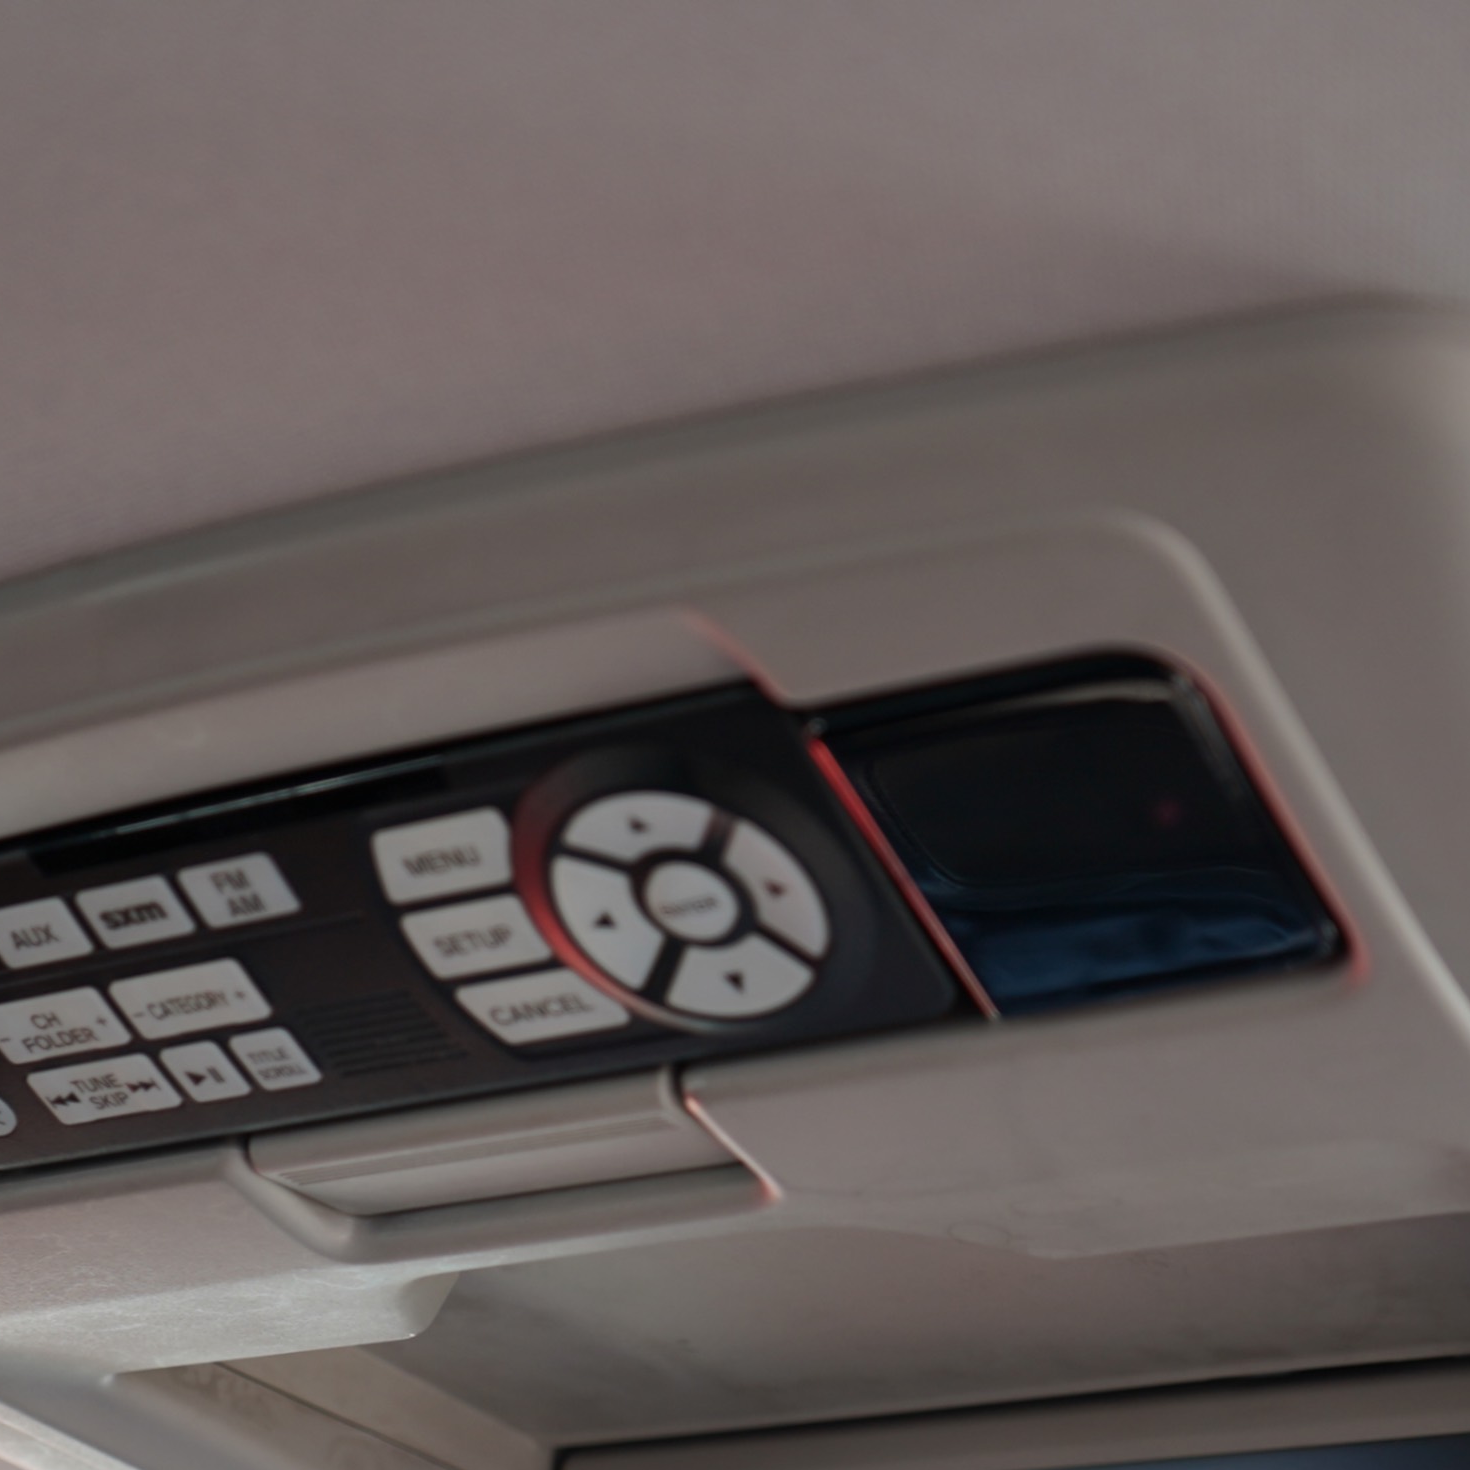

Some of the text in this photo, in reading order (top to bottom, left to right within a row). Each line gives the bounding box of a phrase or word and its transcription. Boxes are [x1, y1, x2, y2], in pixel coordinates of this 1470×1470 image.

[402, 845, 481, 876] MENU
[10, 925, 59, 950] AUX
[434, 924, 512, 956] SETUP
[146, 990, 231, 1022] CATEGORY
[489, 993, 593, 1028] CANCEL
[30, 1012, 61, 1032] CH
[21, 1026, 100, 1054] FOLDER
[69, 1072, 121, 1095] TUNE
[88, 1089, 131, 1111] SKIP
